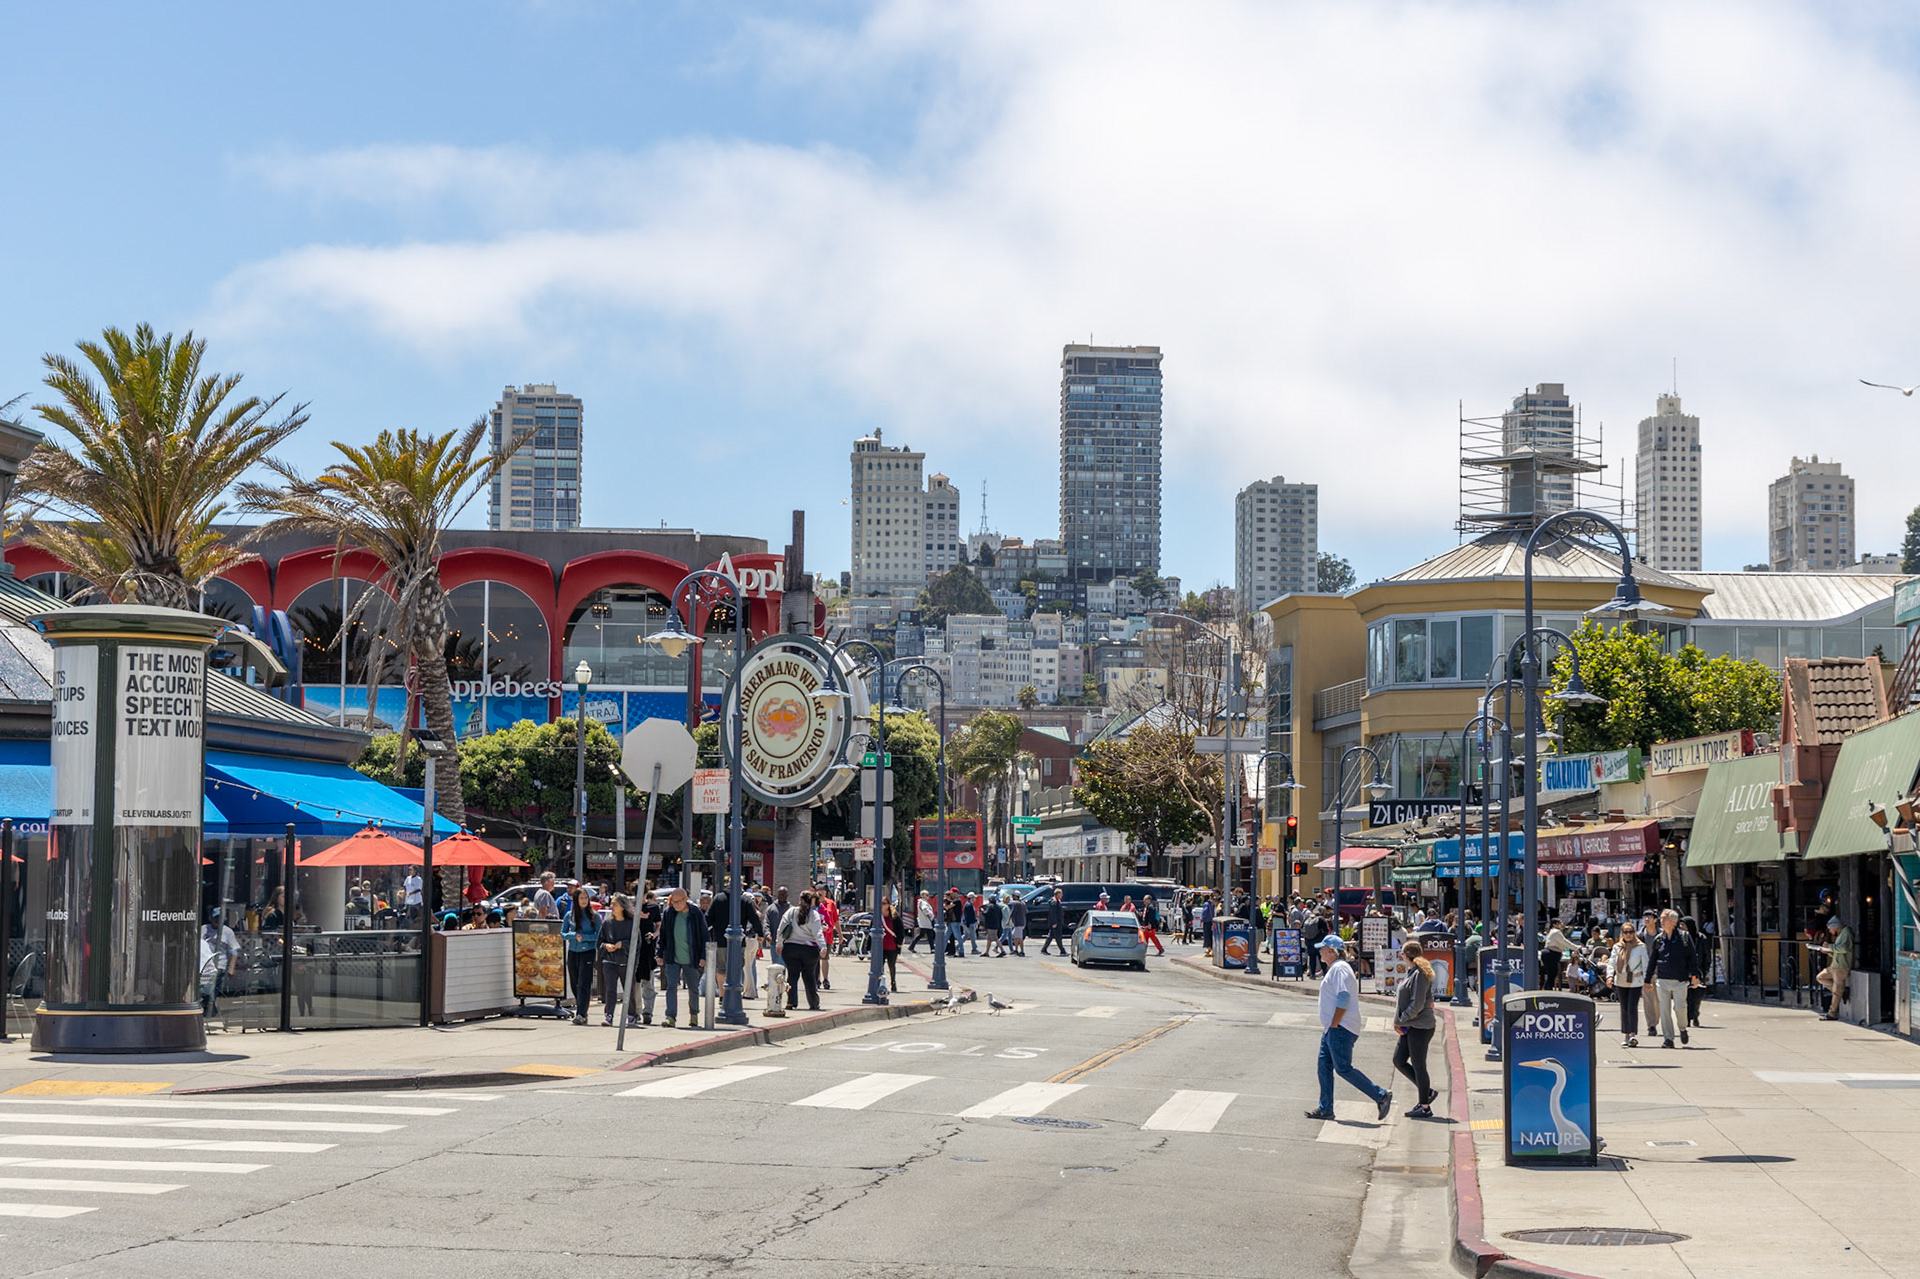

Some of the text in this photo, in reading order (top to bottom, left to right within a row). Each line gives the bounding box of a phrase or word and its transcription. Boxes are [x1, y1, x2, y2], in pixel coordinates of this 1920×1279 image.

[126, 653, 202, 674] THE MOST
[126, 675, 202, 696] ACCURATE
[799, 667, 827, 721] WHRF
[125, 696, 192, 717] SPEECH
[125, 718, 202, 738] TEXT MOD
[746, 749, 768, 774] SAN
[768, 727, 825, 779] FRANCISCO
[1654, 747, 1683, 771] SABELLA
[1691, 744, 1700, 765] LA
[1702, 739, 1729, 763] TORRE
[122, 809, 192, 819] ELEVENLABS.IO/STT
[1229, 923, 1245, 931] PORT
[1427, 940, 1449, 949] PORT
[1491, 958, 1521, 970] PRT
[1538, 1001, 1560, 1010] Bigbelly
[1525, 1013, 1576, 1033] PORT
[1515, 1031, 1585, 1040] SAN FRANCISCO
[829, 1041, 1050, 1060] STOP
[1520, 1131, 1582, 1147] NATURE
